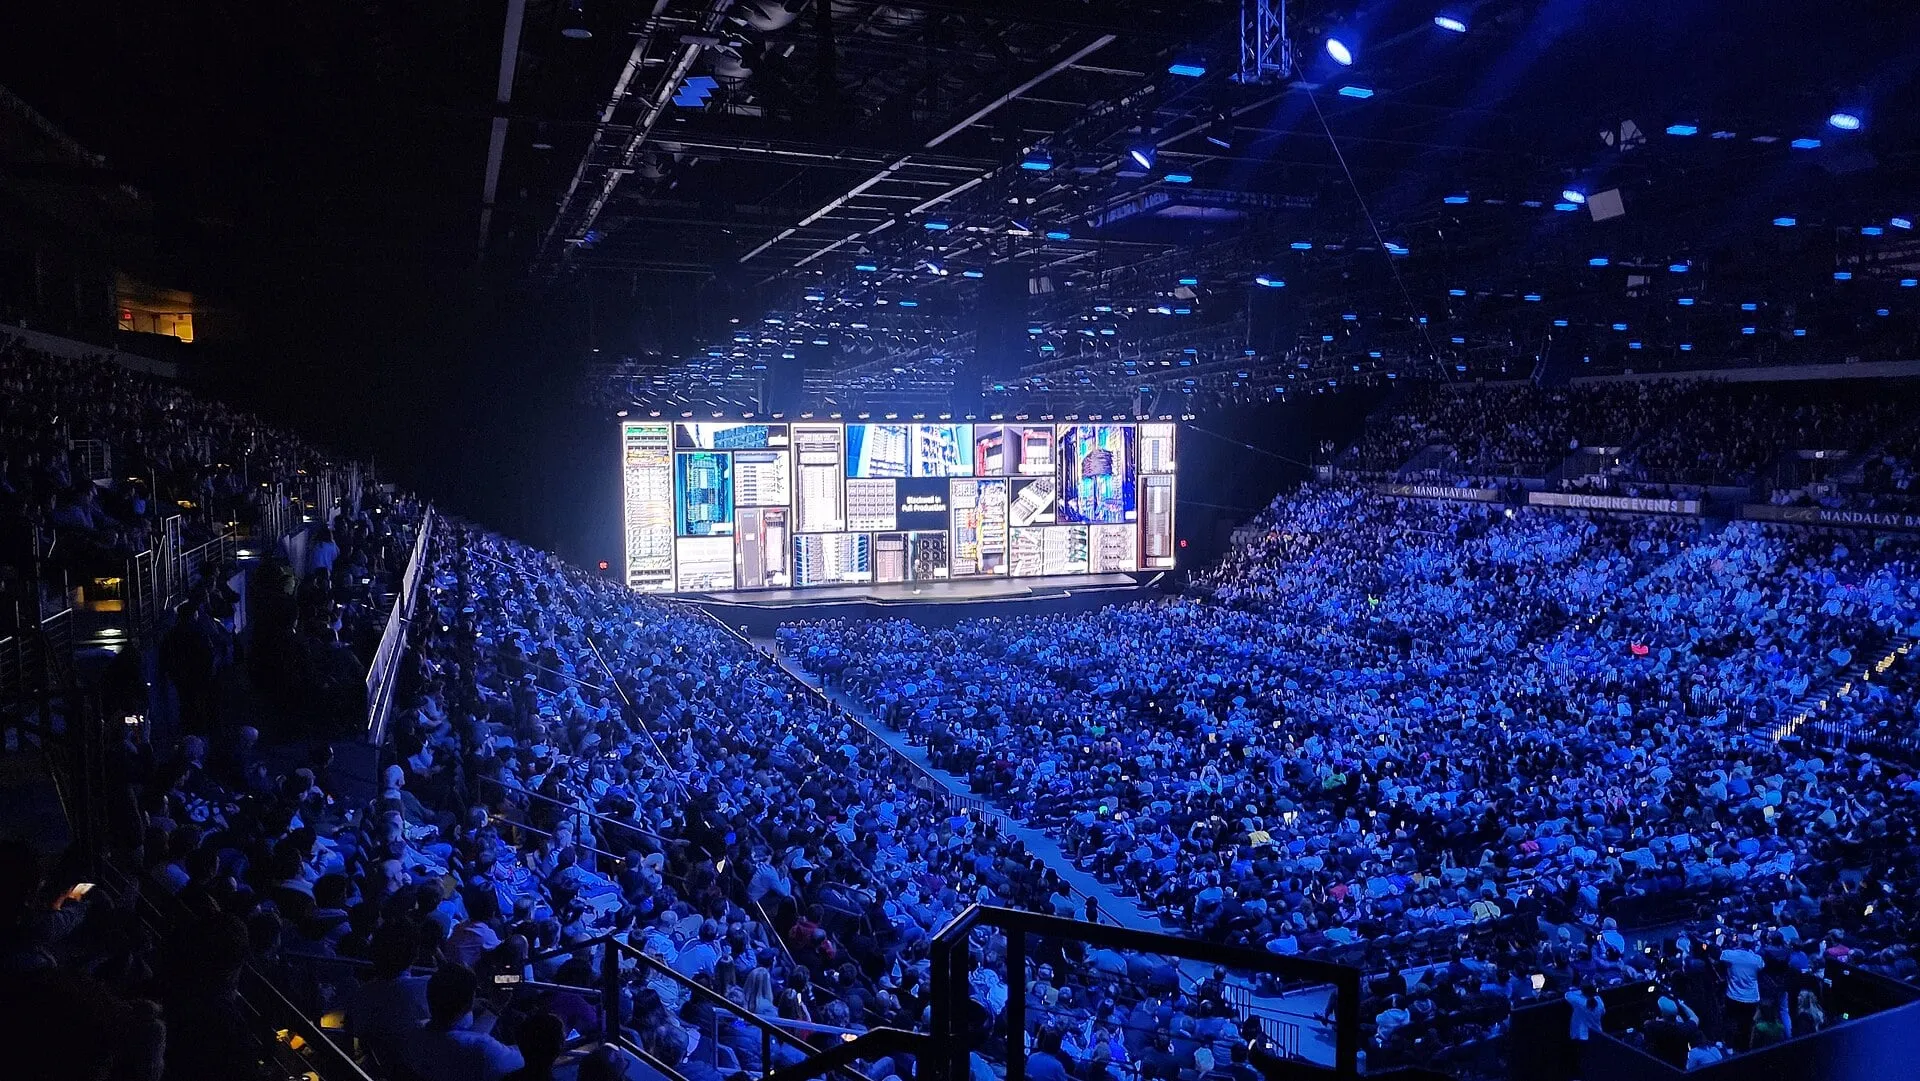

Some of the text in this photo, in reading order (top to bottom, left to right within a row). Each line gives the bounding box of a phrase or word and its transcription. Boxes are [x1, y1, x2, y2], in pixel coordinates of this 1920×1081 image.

[1413, 486, 1479, 499] MANDALAY BAY
[1568, 495, 1678, 513] UPCOMING EVENTS
[1820, 511, 1900, 525] MANDALAY
